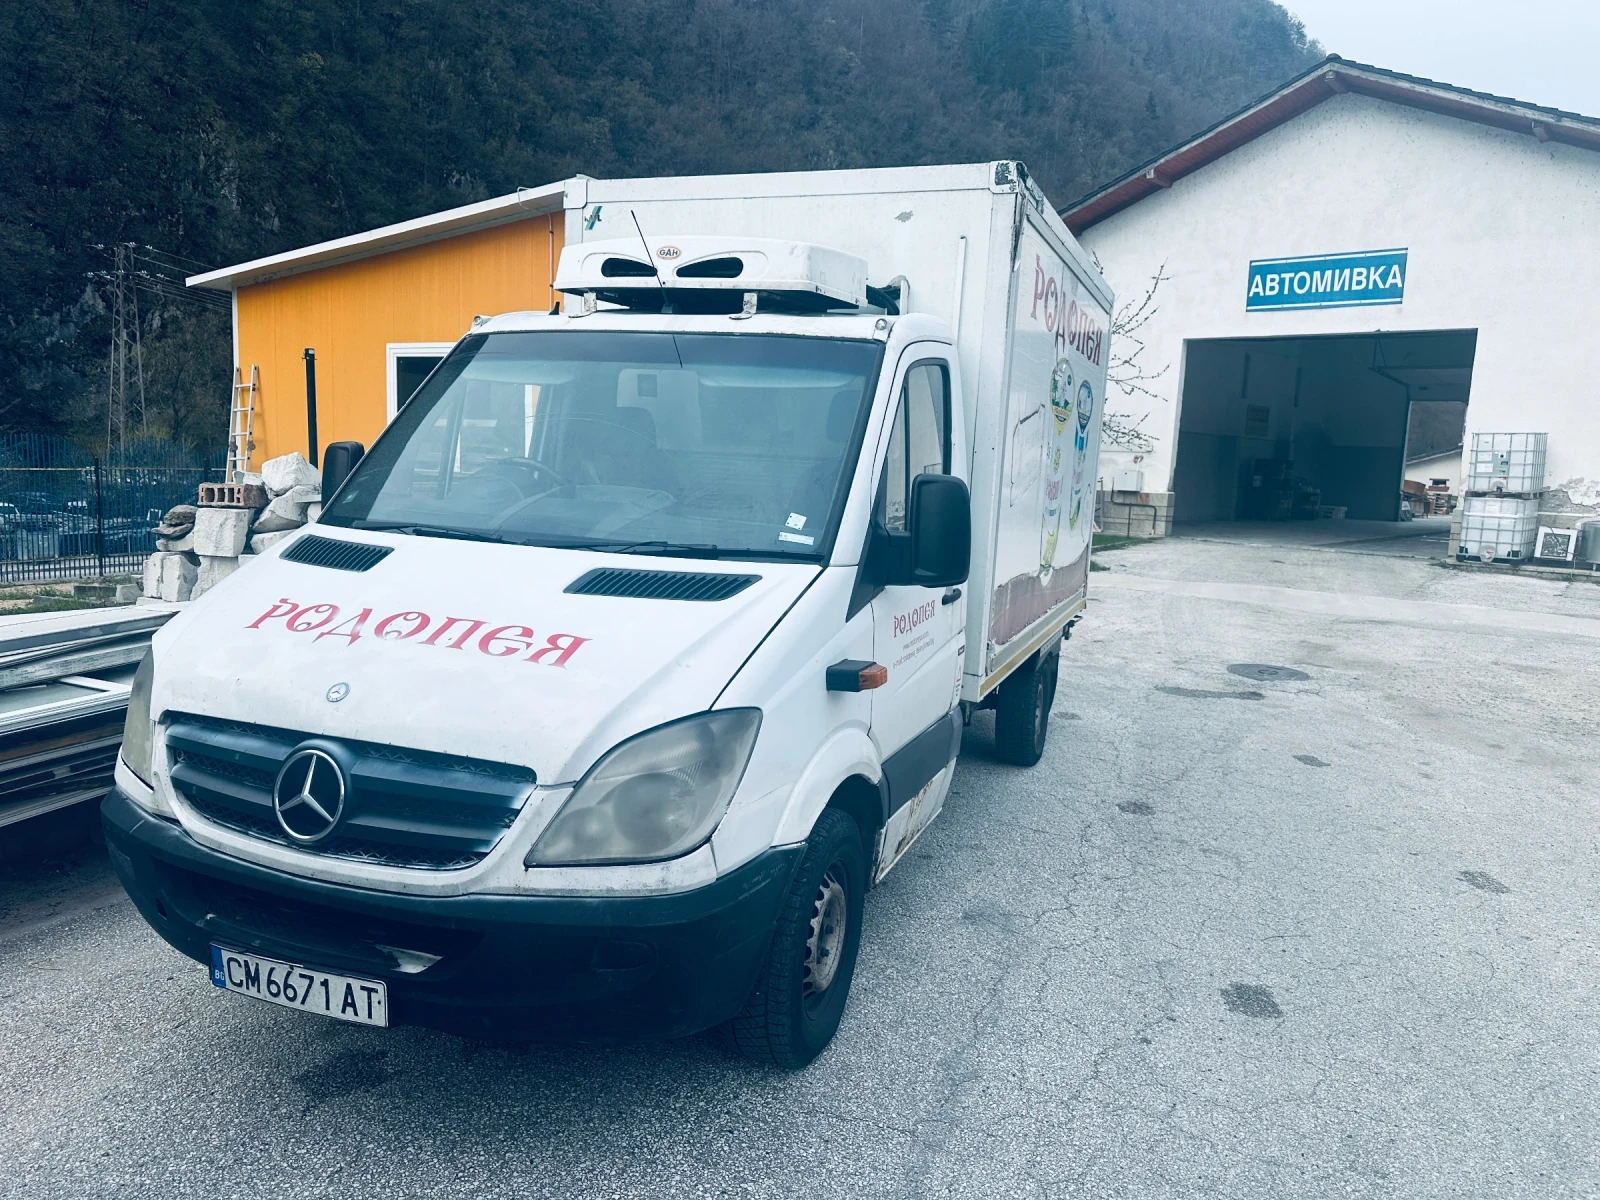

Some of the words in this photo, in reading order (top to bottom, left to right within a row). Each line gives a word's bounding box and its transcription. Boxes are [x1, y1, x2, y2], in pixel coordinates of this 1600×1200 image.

[659, 248, 678, 257] GAH
[1249, 264, 1403, 297] АВТОМИВКА
[214, 969, 225, 981] BG
